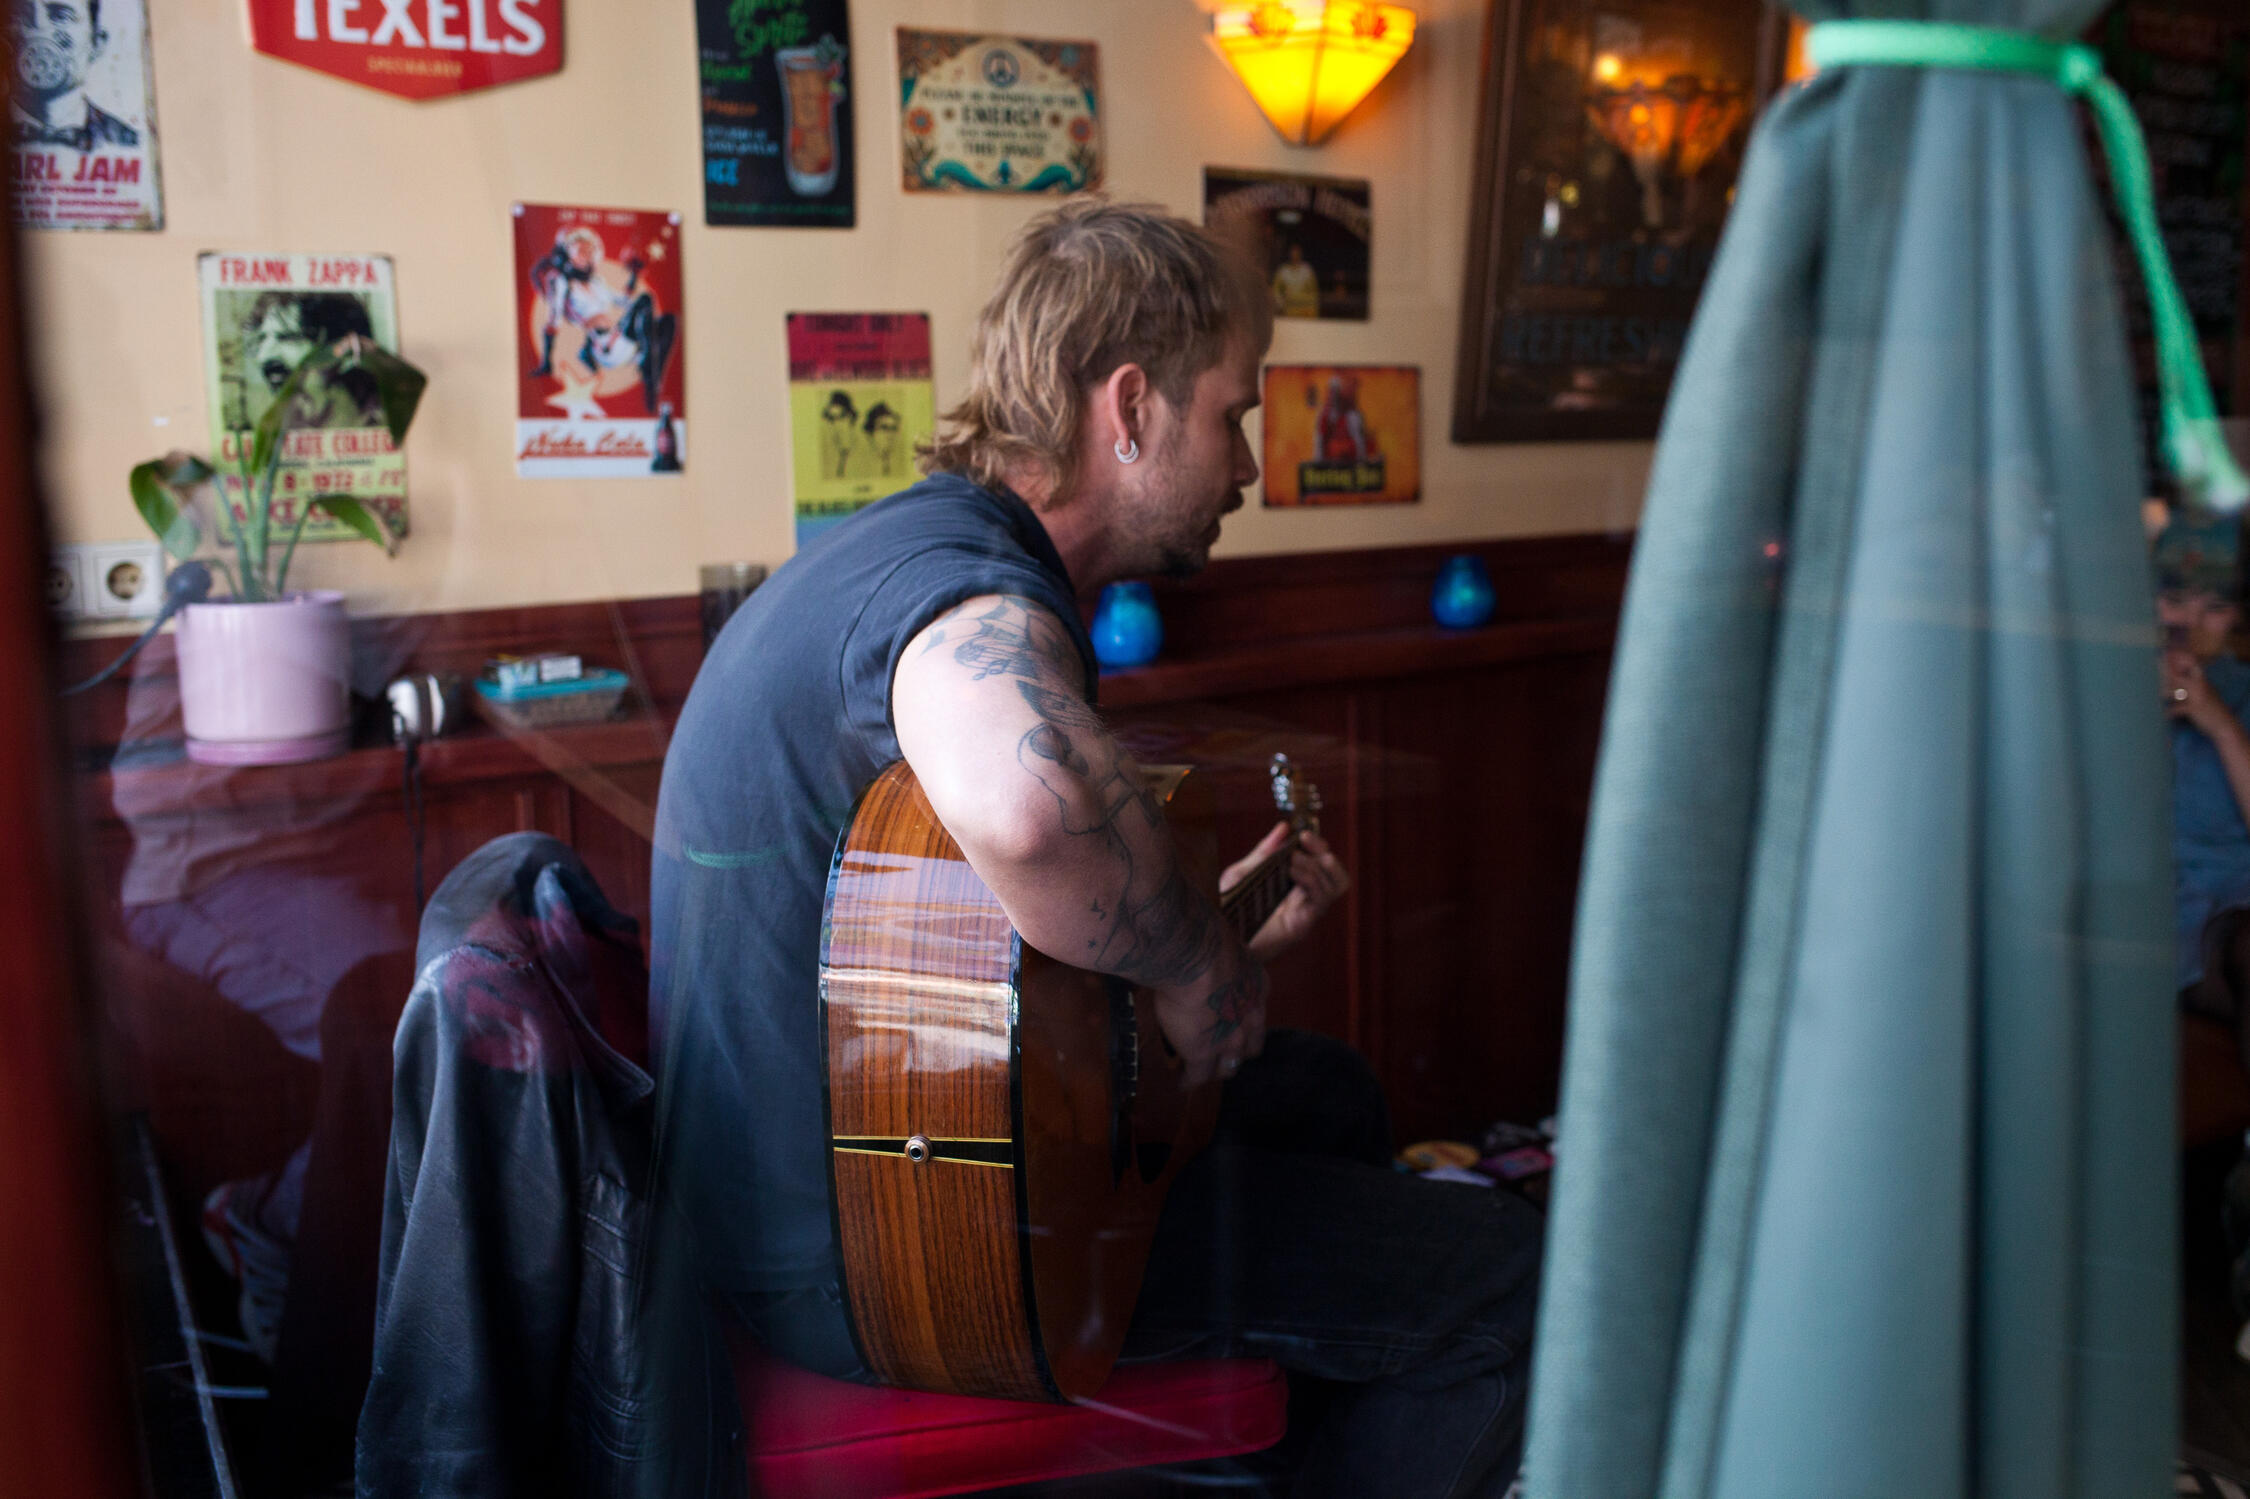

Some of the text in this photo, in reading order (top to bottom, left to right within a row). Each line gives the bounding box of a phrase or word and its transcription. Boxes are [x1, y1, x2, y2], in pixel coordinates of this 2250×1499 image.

[962, 104, 1042, 127] ENERGY
[10, 151, 141, 184] ARL JAM
[219, 257, 379, 286] FRANK ZAPPA
